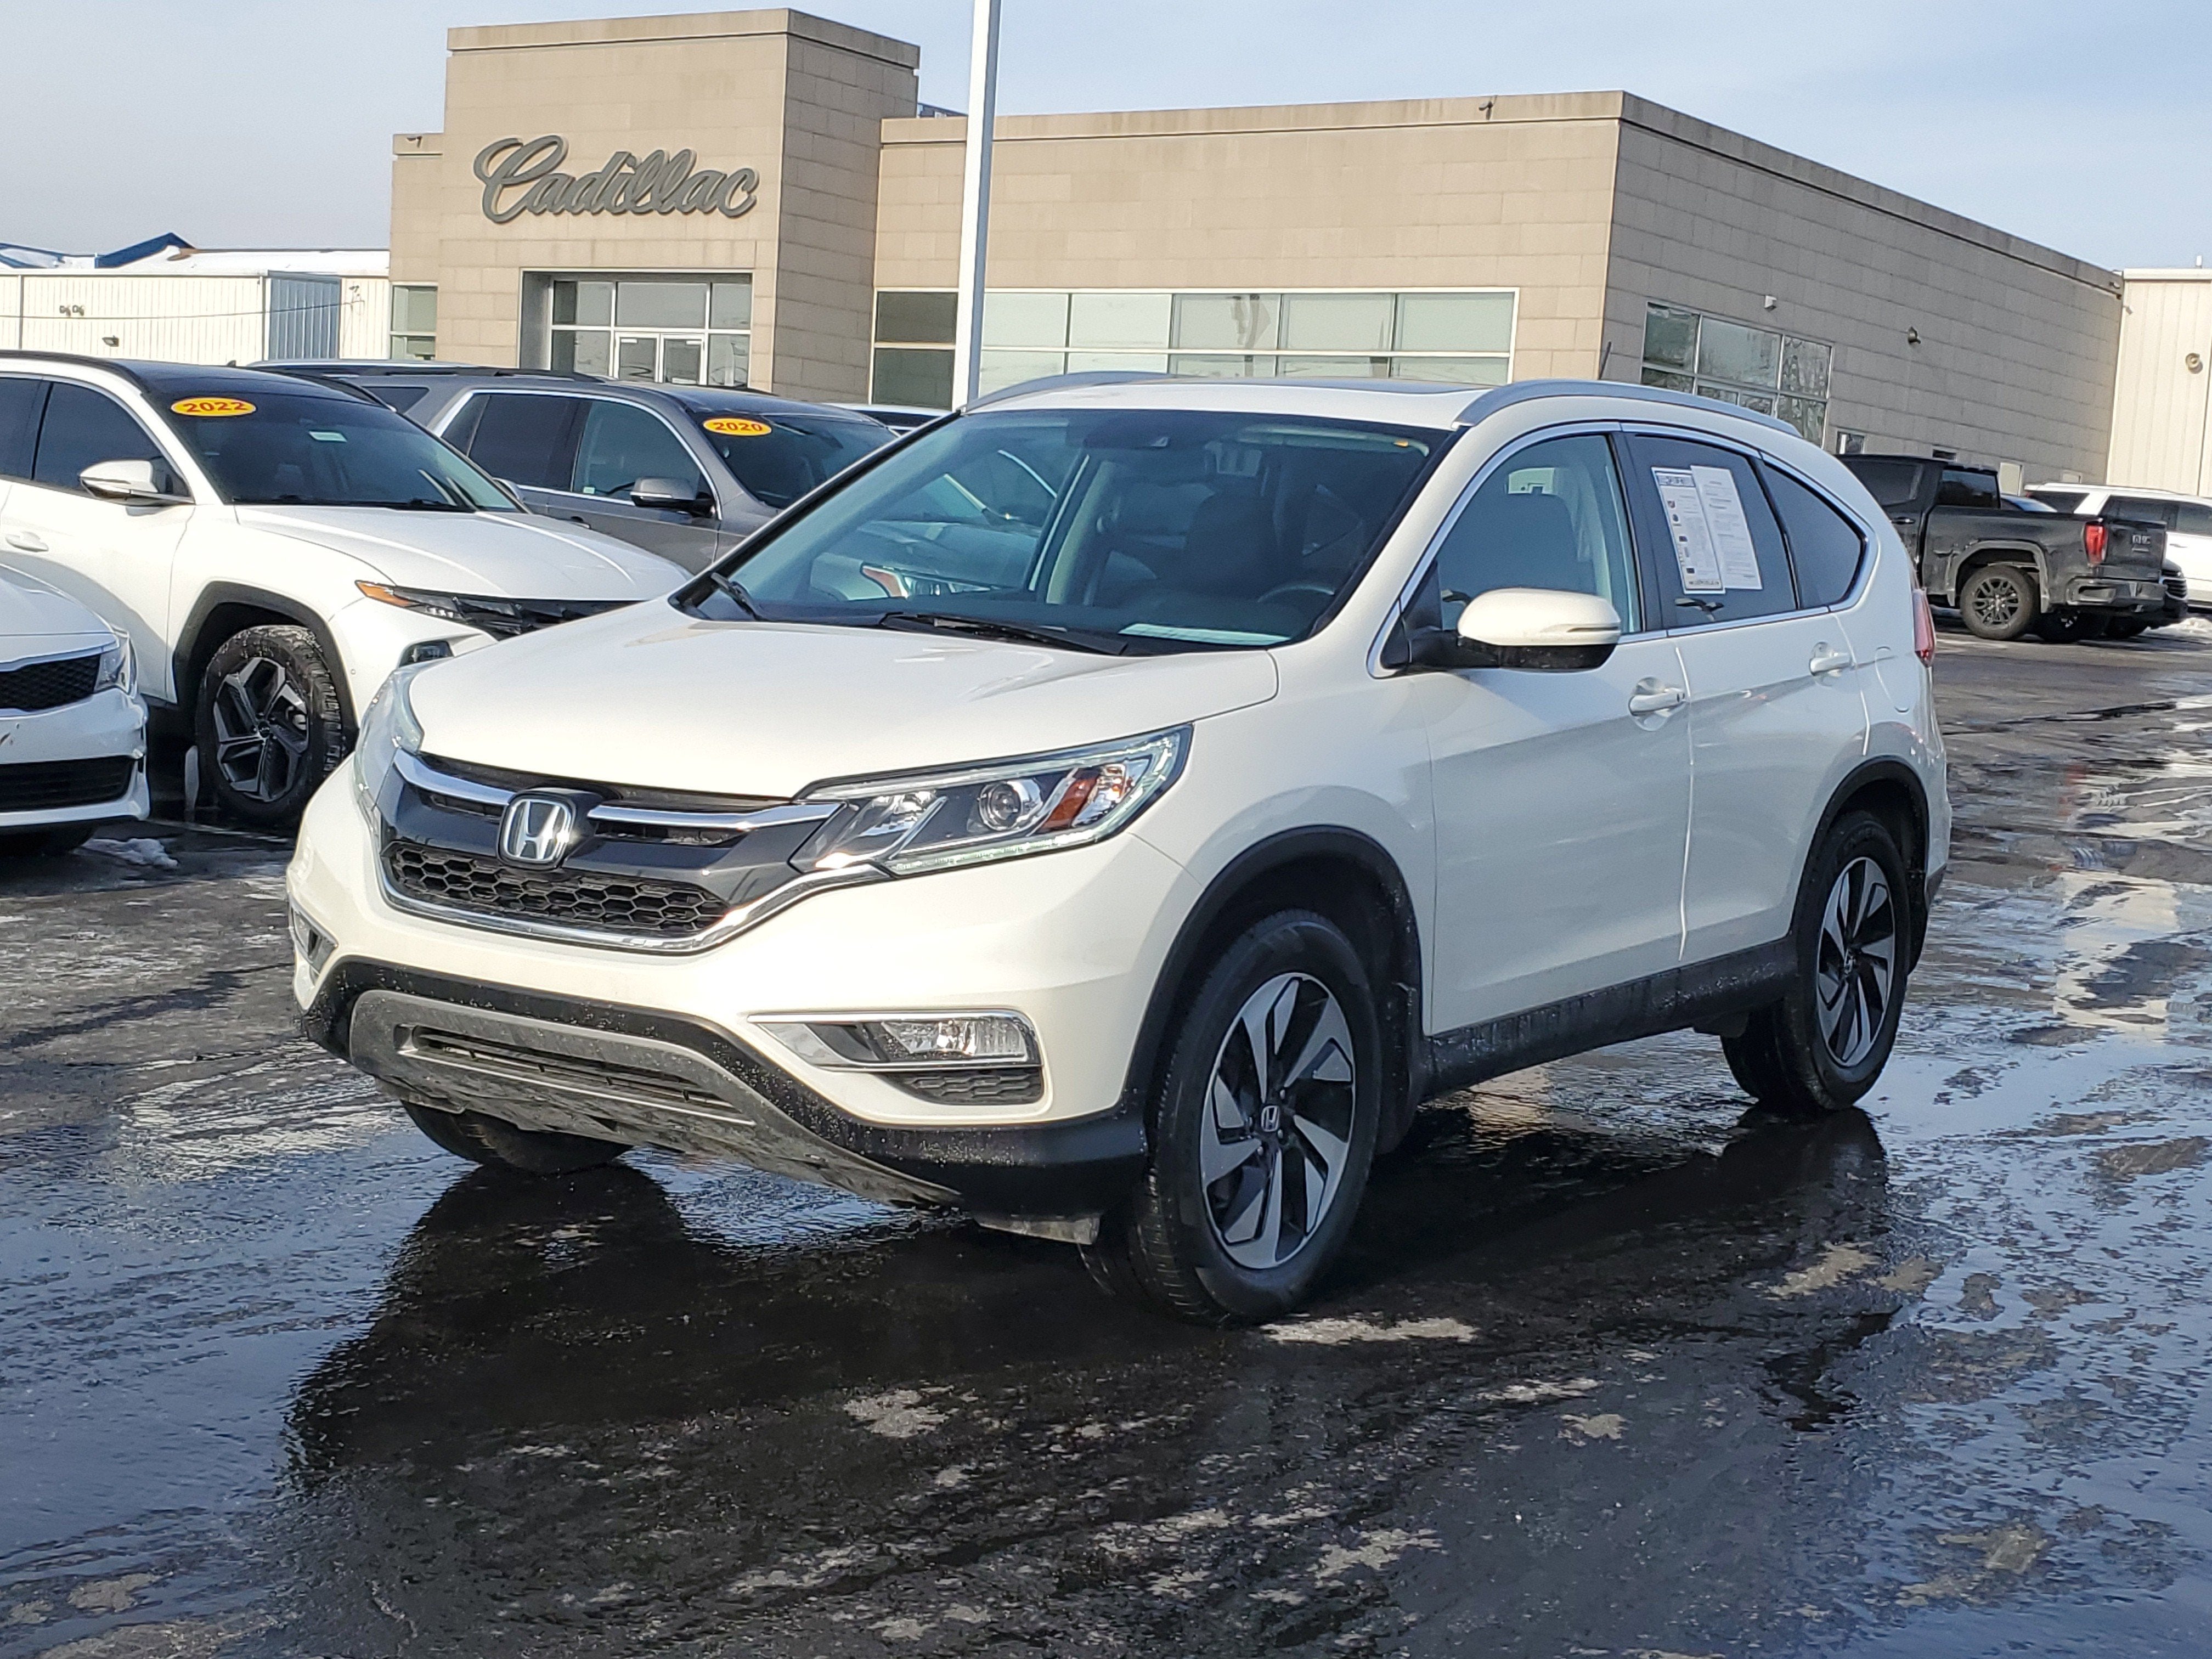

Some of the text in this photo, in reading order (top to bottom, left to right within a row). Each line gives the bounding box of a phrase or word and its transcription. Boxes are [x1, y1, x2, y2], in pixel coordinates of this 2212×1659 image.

[472, 134, 760, 224] Cadillac
[183, 400, 249, 413] 2022
[713, 422, 763, 431] 2020
